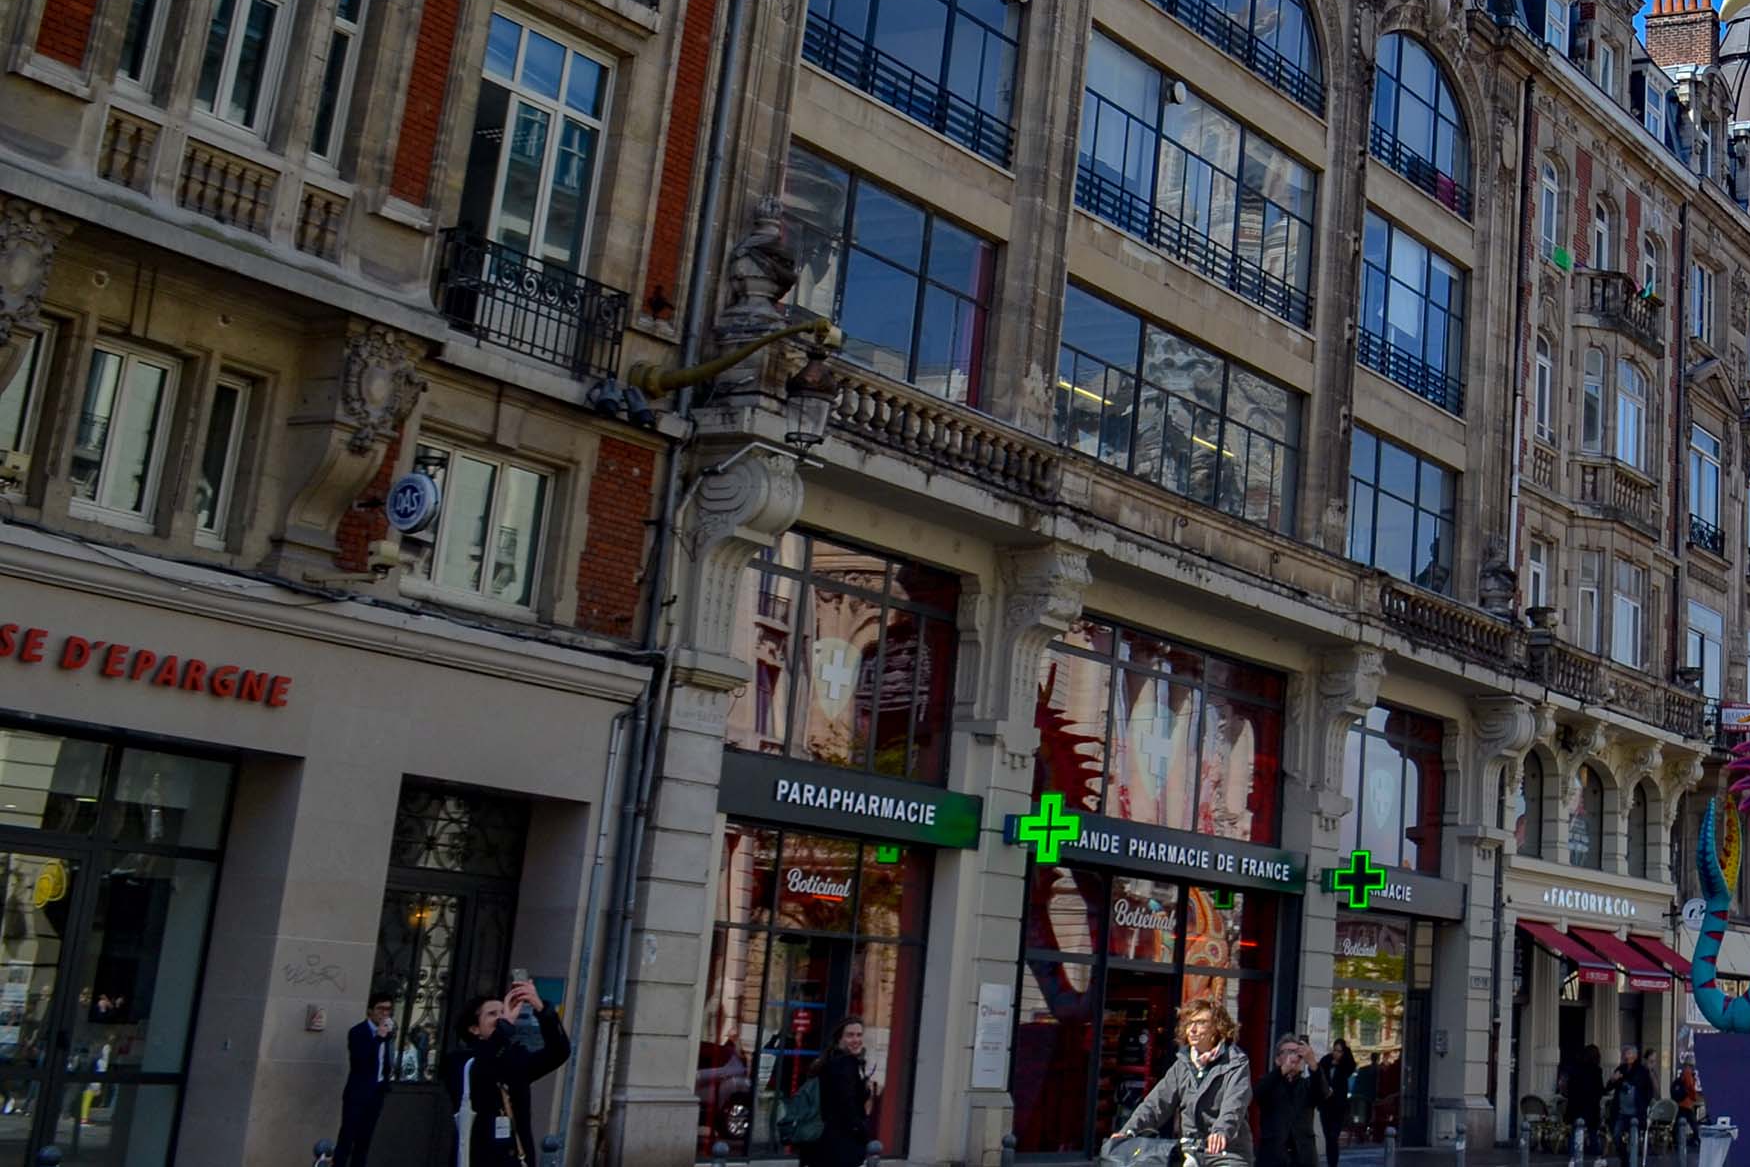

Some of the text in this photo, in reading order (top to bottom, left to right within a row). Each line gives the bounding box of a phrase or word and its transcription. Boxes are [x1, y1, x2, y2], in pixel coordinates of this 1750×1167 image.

[61, 635, 292, 707] D'EPARGNE
[776, 780, 936, 825] PARAPHARMACIE
[1061, 830, 1290, 881] ANDE PHARMACIE DE FRANCE
[787, 868, 852, 897] Boticinal
[1114, 898, 1176, 930] Boticinal
